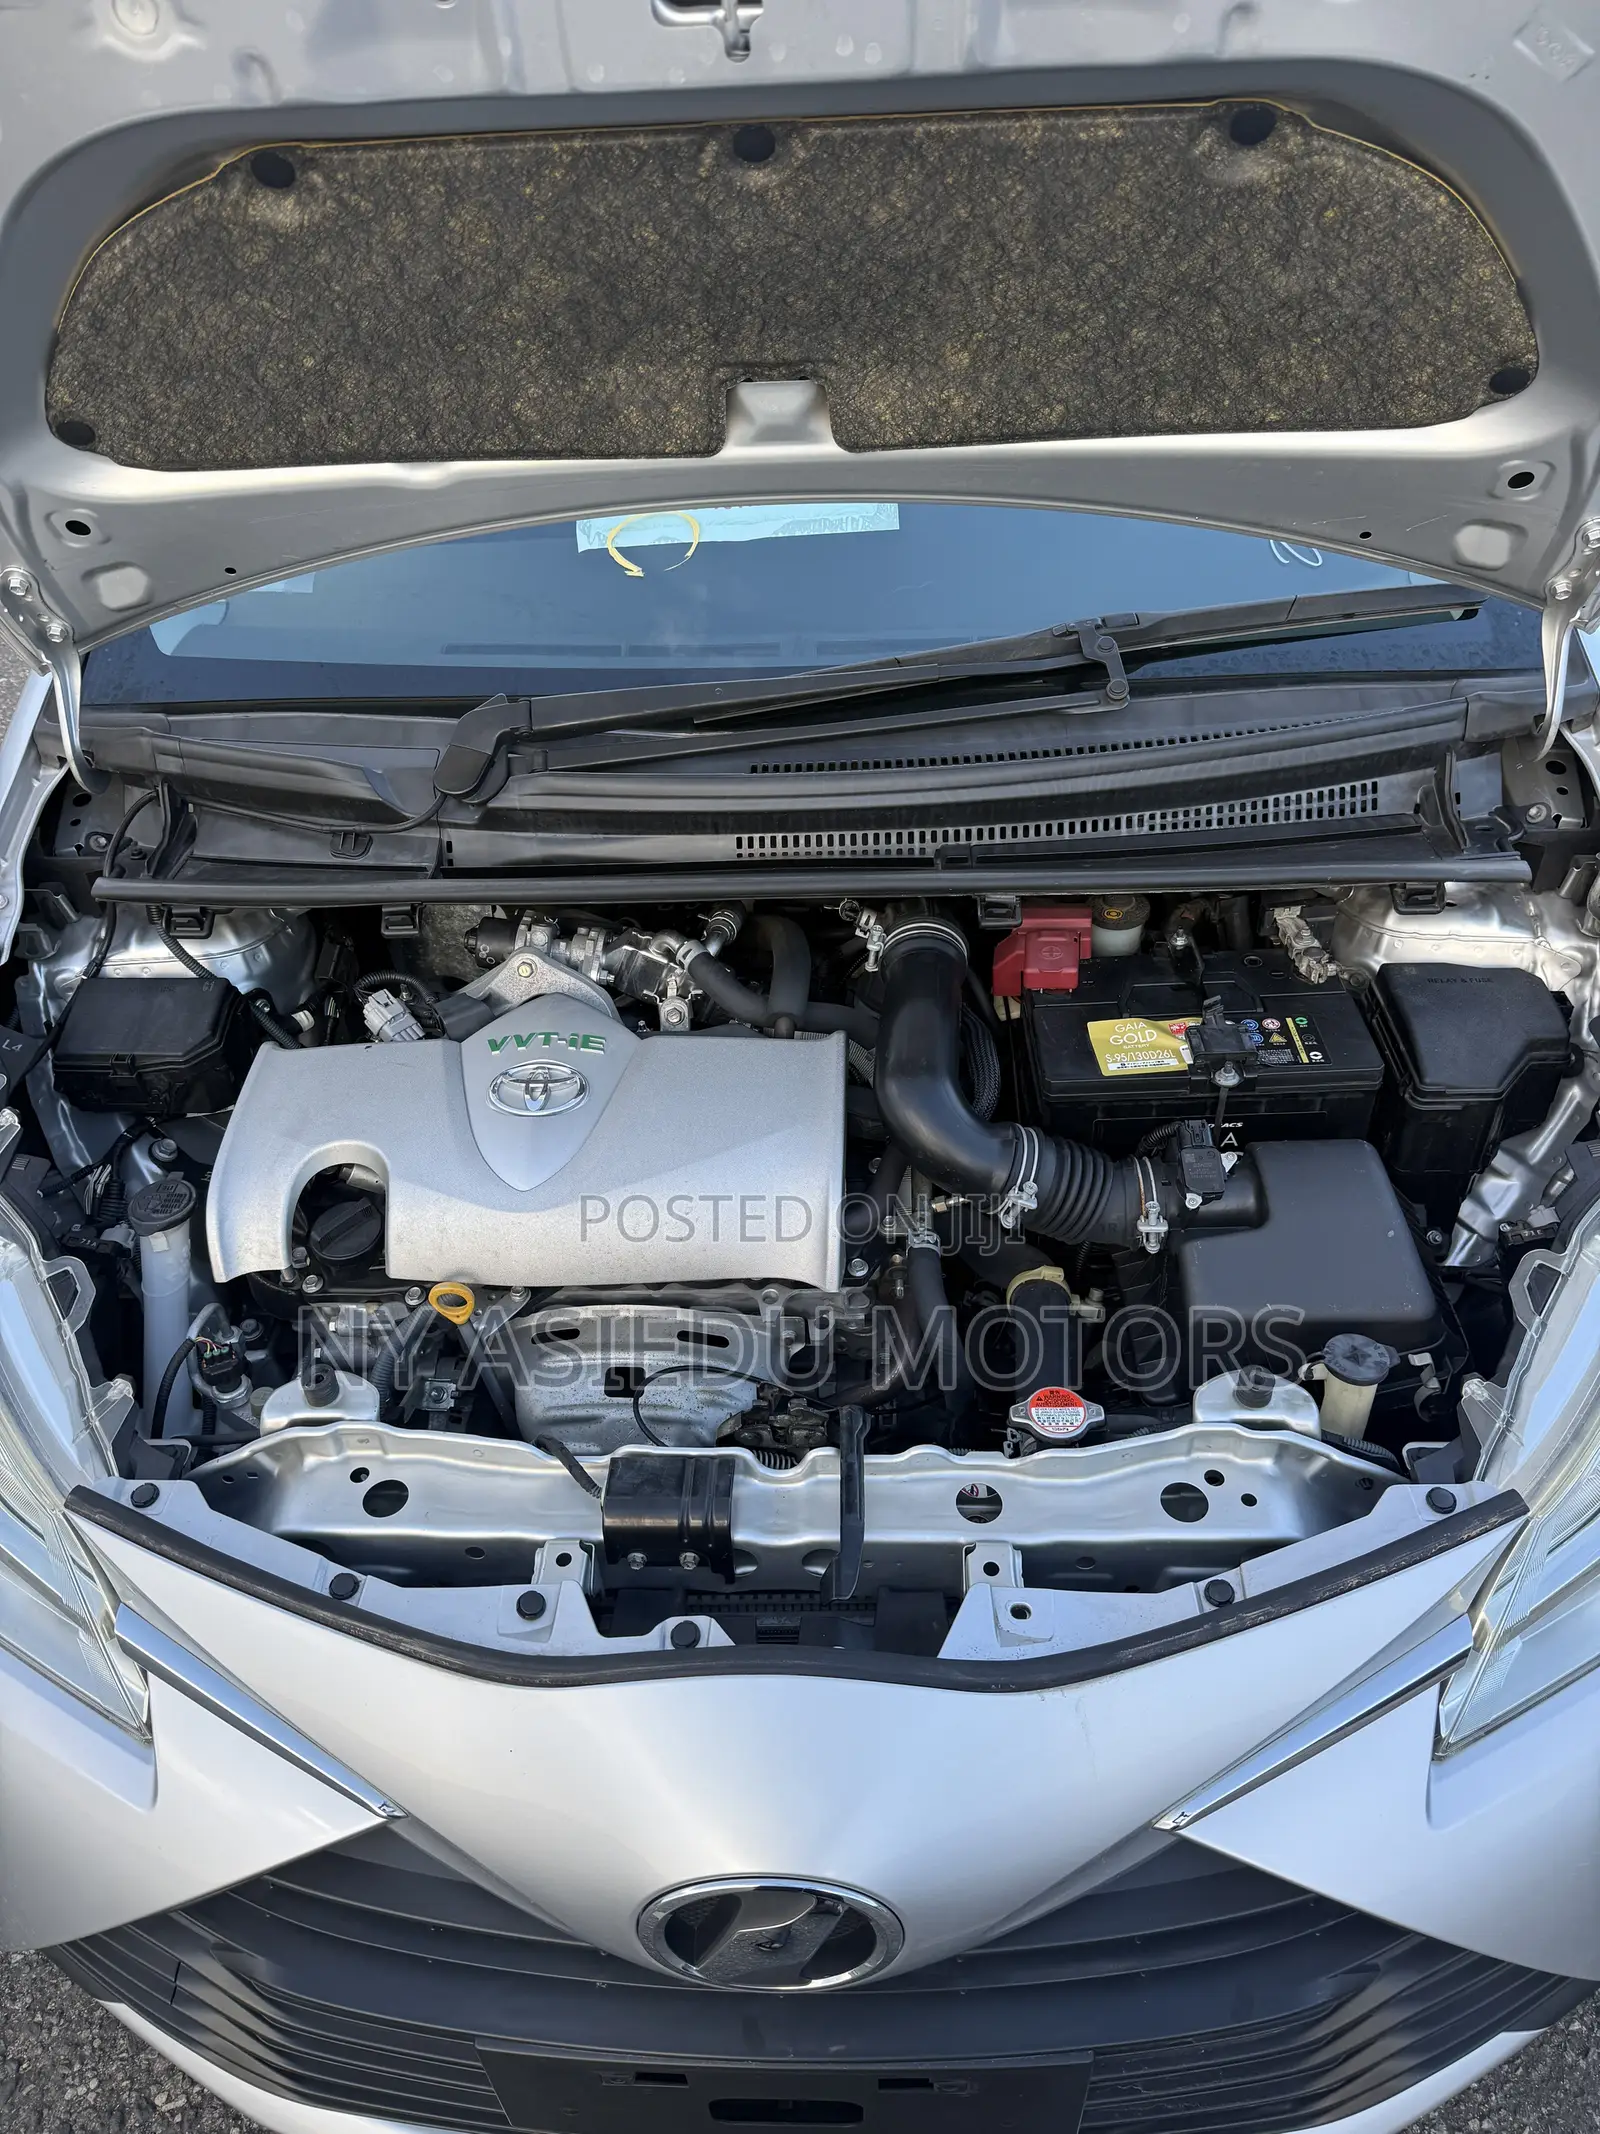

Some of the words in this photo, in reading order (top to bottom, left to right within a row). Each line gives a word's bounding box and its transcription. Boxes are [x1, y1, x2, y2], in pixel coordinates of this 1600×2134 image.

[1114, 1021, 1148, 1033] GAIA
[1109, 1029, 1158, 1046] GOLD
[1104, 1049, 1177, 1063] S-95/130D26L
